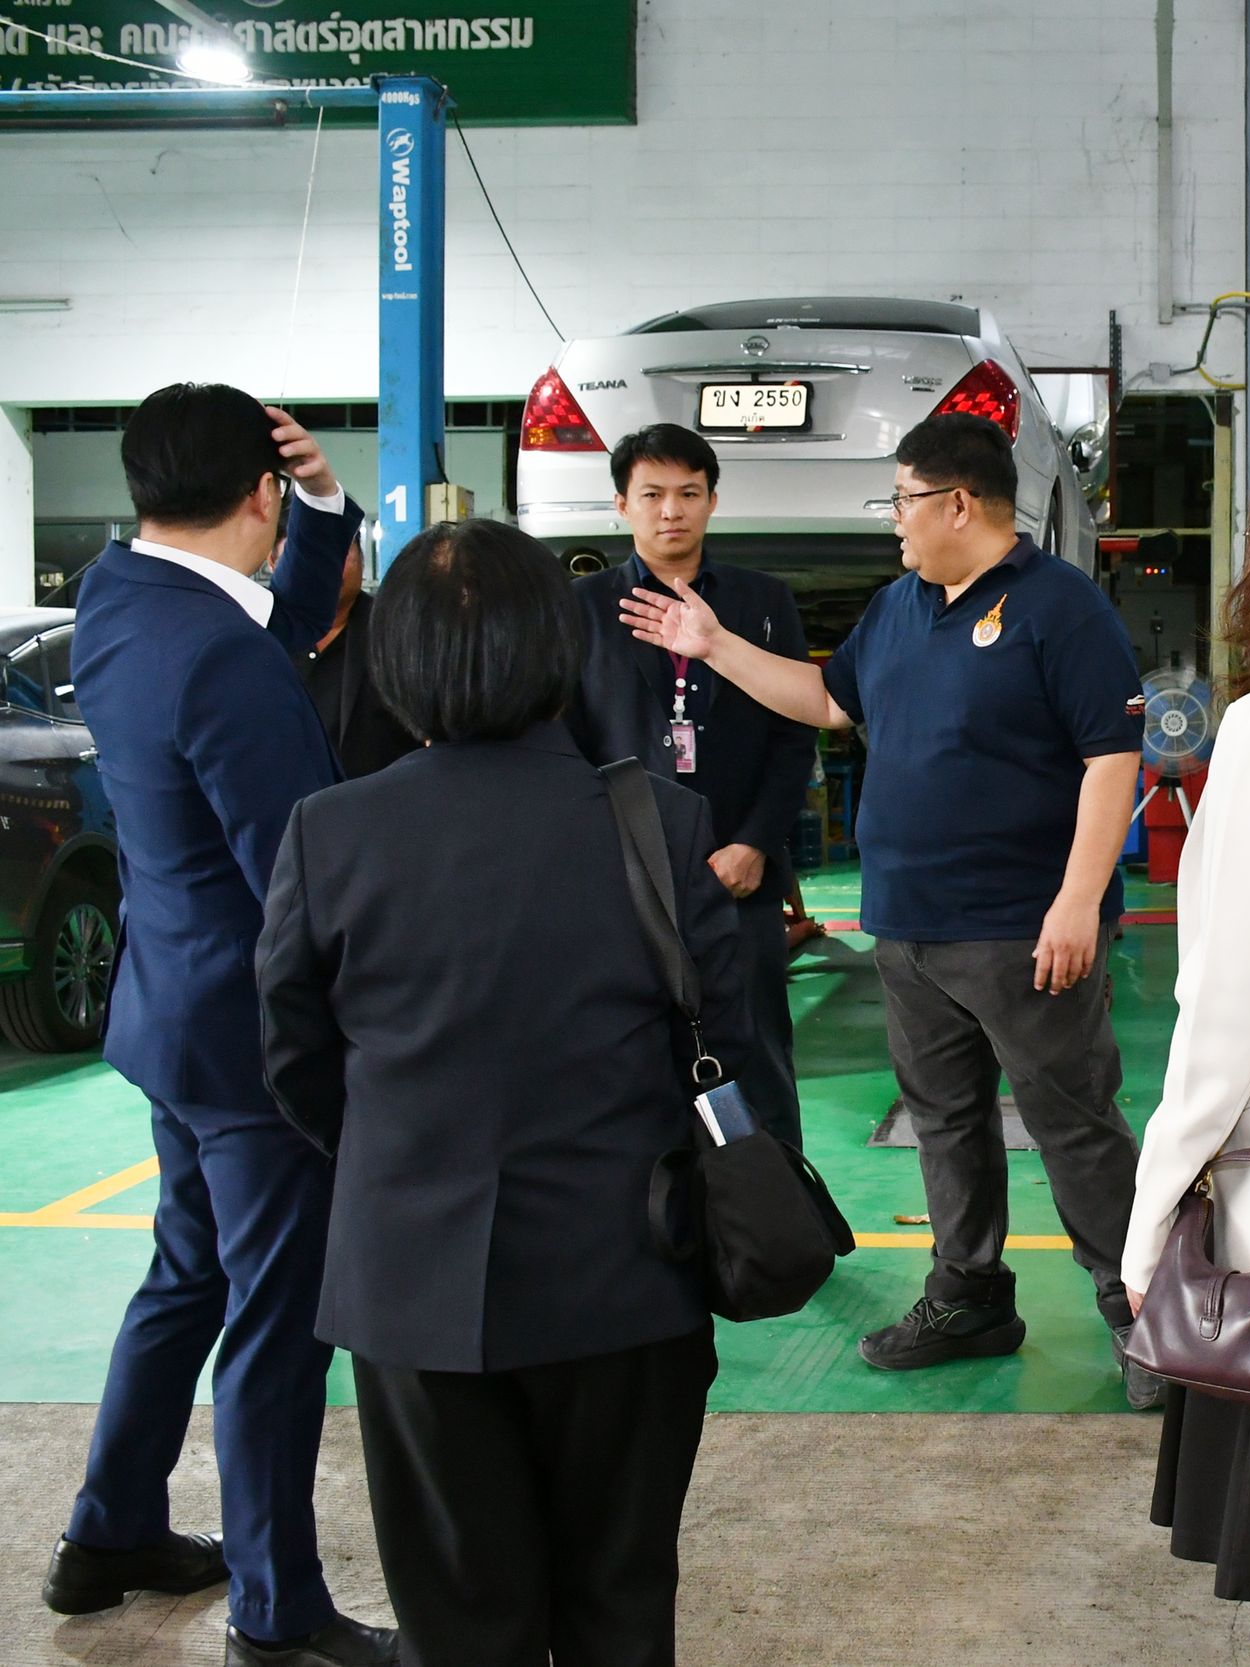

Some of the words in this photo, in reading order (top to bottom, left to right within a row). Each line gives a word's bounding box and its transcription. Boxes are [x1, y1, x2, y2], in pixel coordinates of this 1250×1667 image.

[47, 23, 104, 55] และ
[389, 156, 413, 272] Waptool
[577, 379, 628, 391] TEANA
[753, 389, 803, 407] 2550
[385, 484, 407, 522] 1
